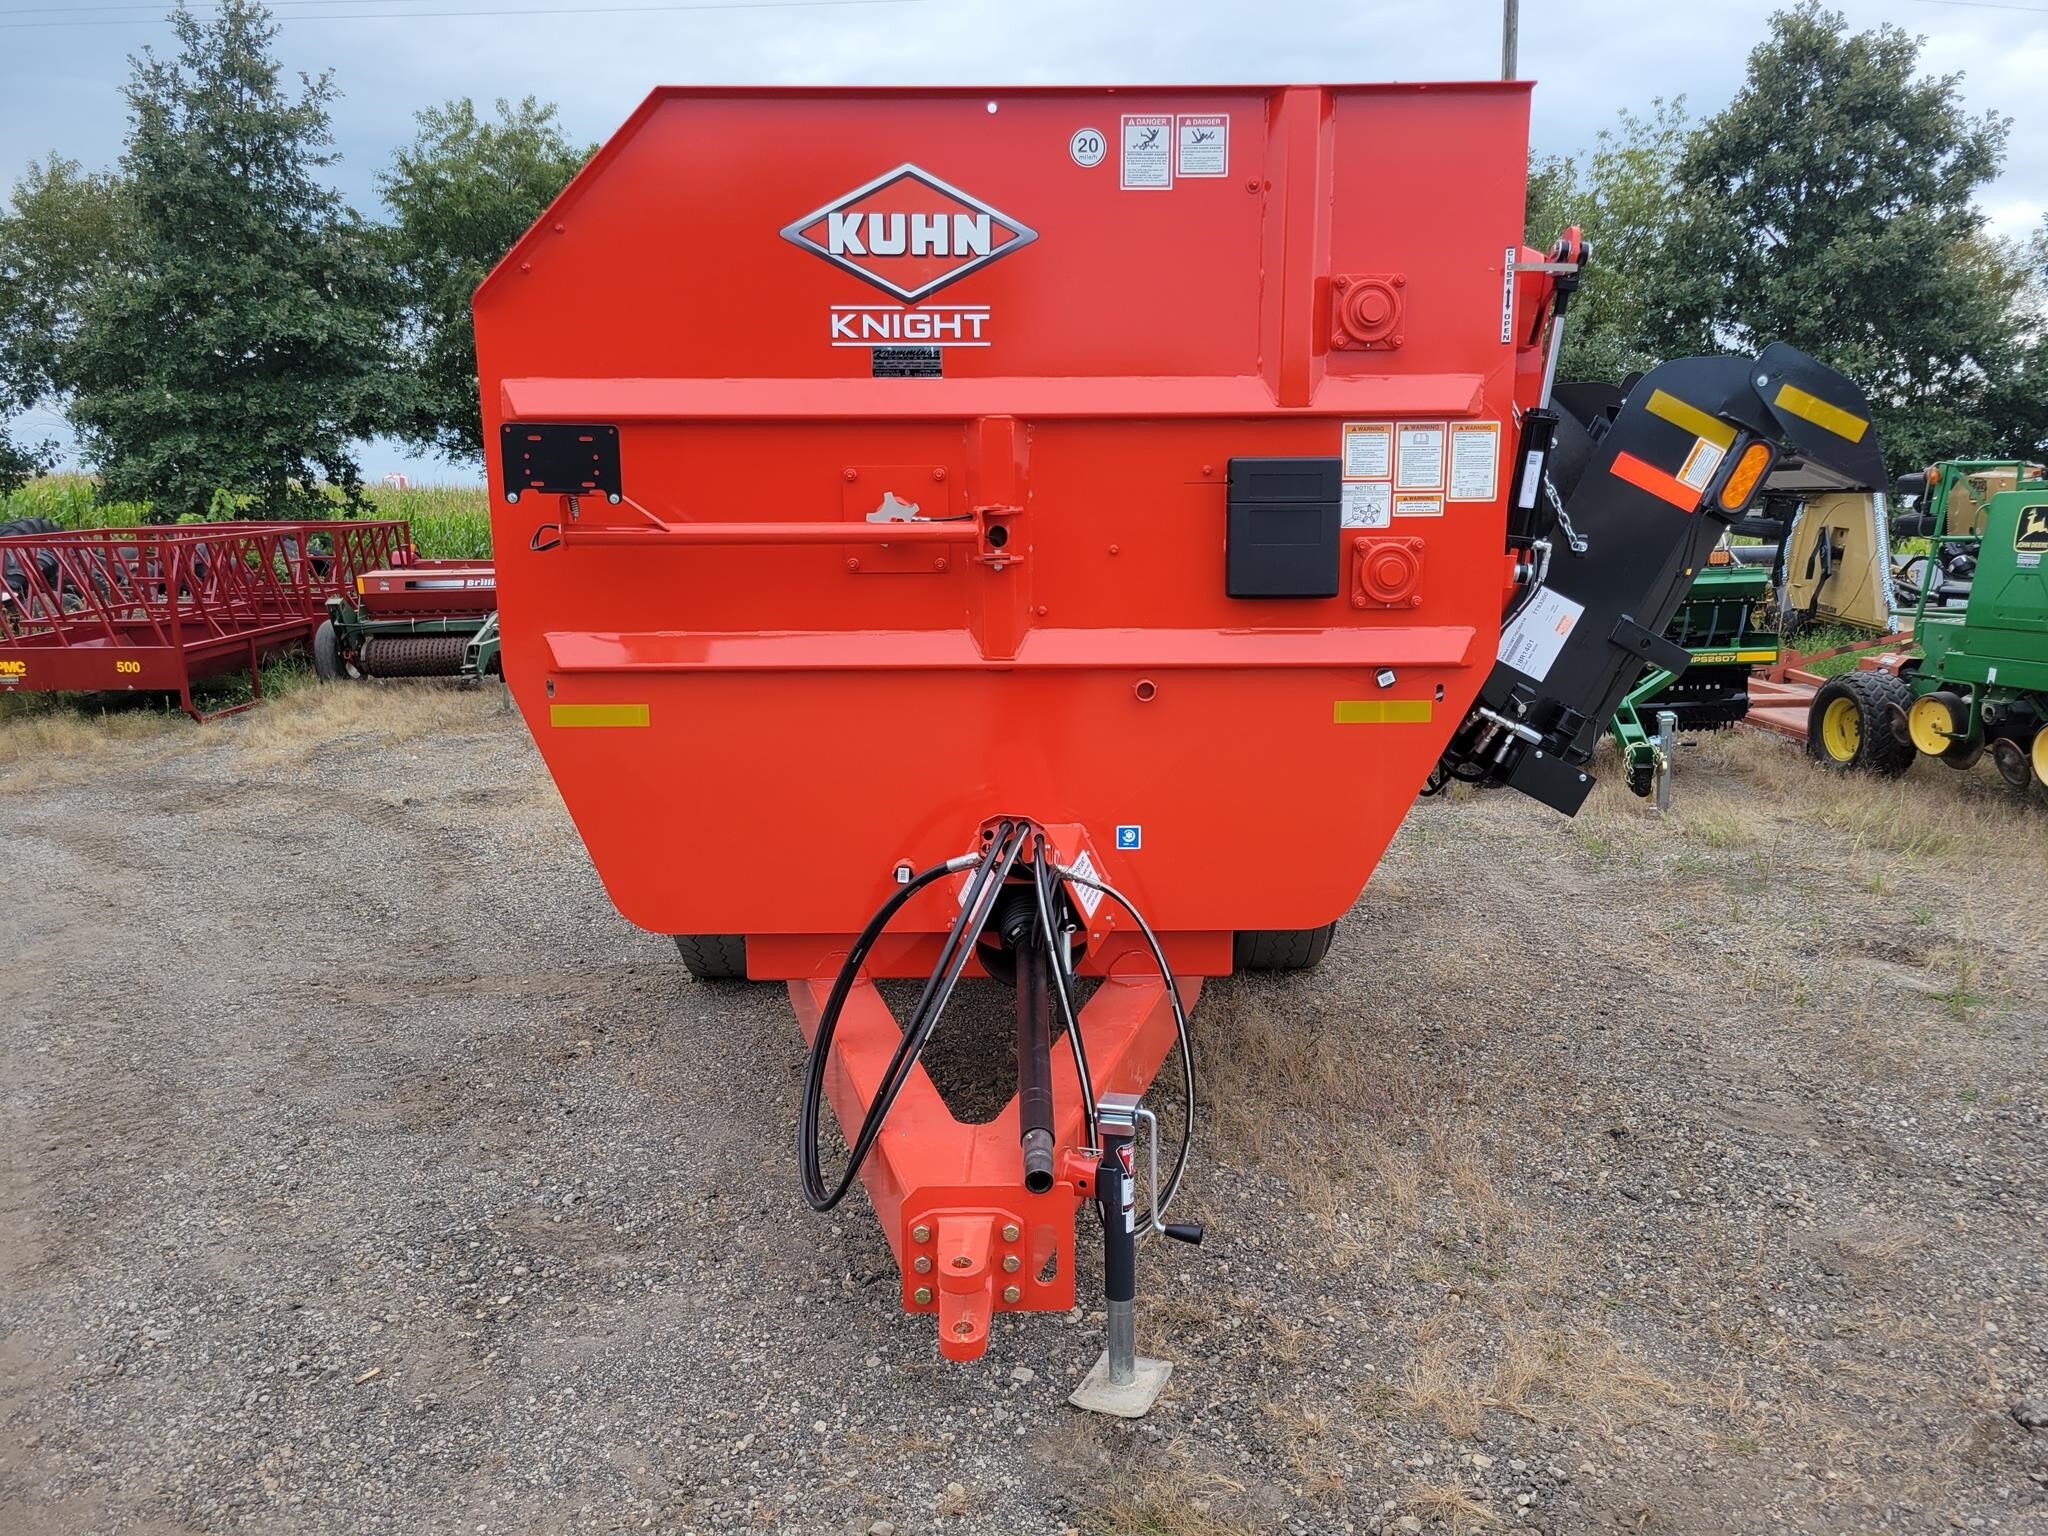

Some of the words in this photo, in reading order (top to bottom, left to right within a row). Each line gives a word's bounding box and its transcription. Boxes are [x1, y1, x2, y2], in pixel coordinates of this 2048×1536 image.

[1078, 138, 1098, 153] 20
[828, 212, 992, 256] KUHN
[831, 313, 990, 339] KNIGHT
[1503, 313, 1511, 341] OPEN
[466, 578, 497, 586] Brilli
[116, 661, 141, 673] 500
